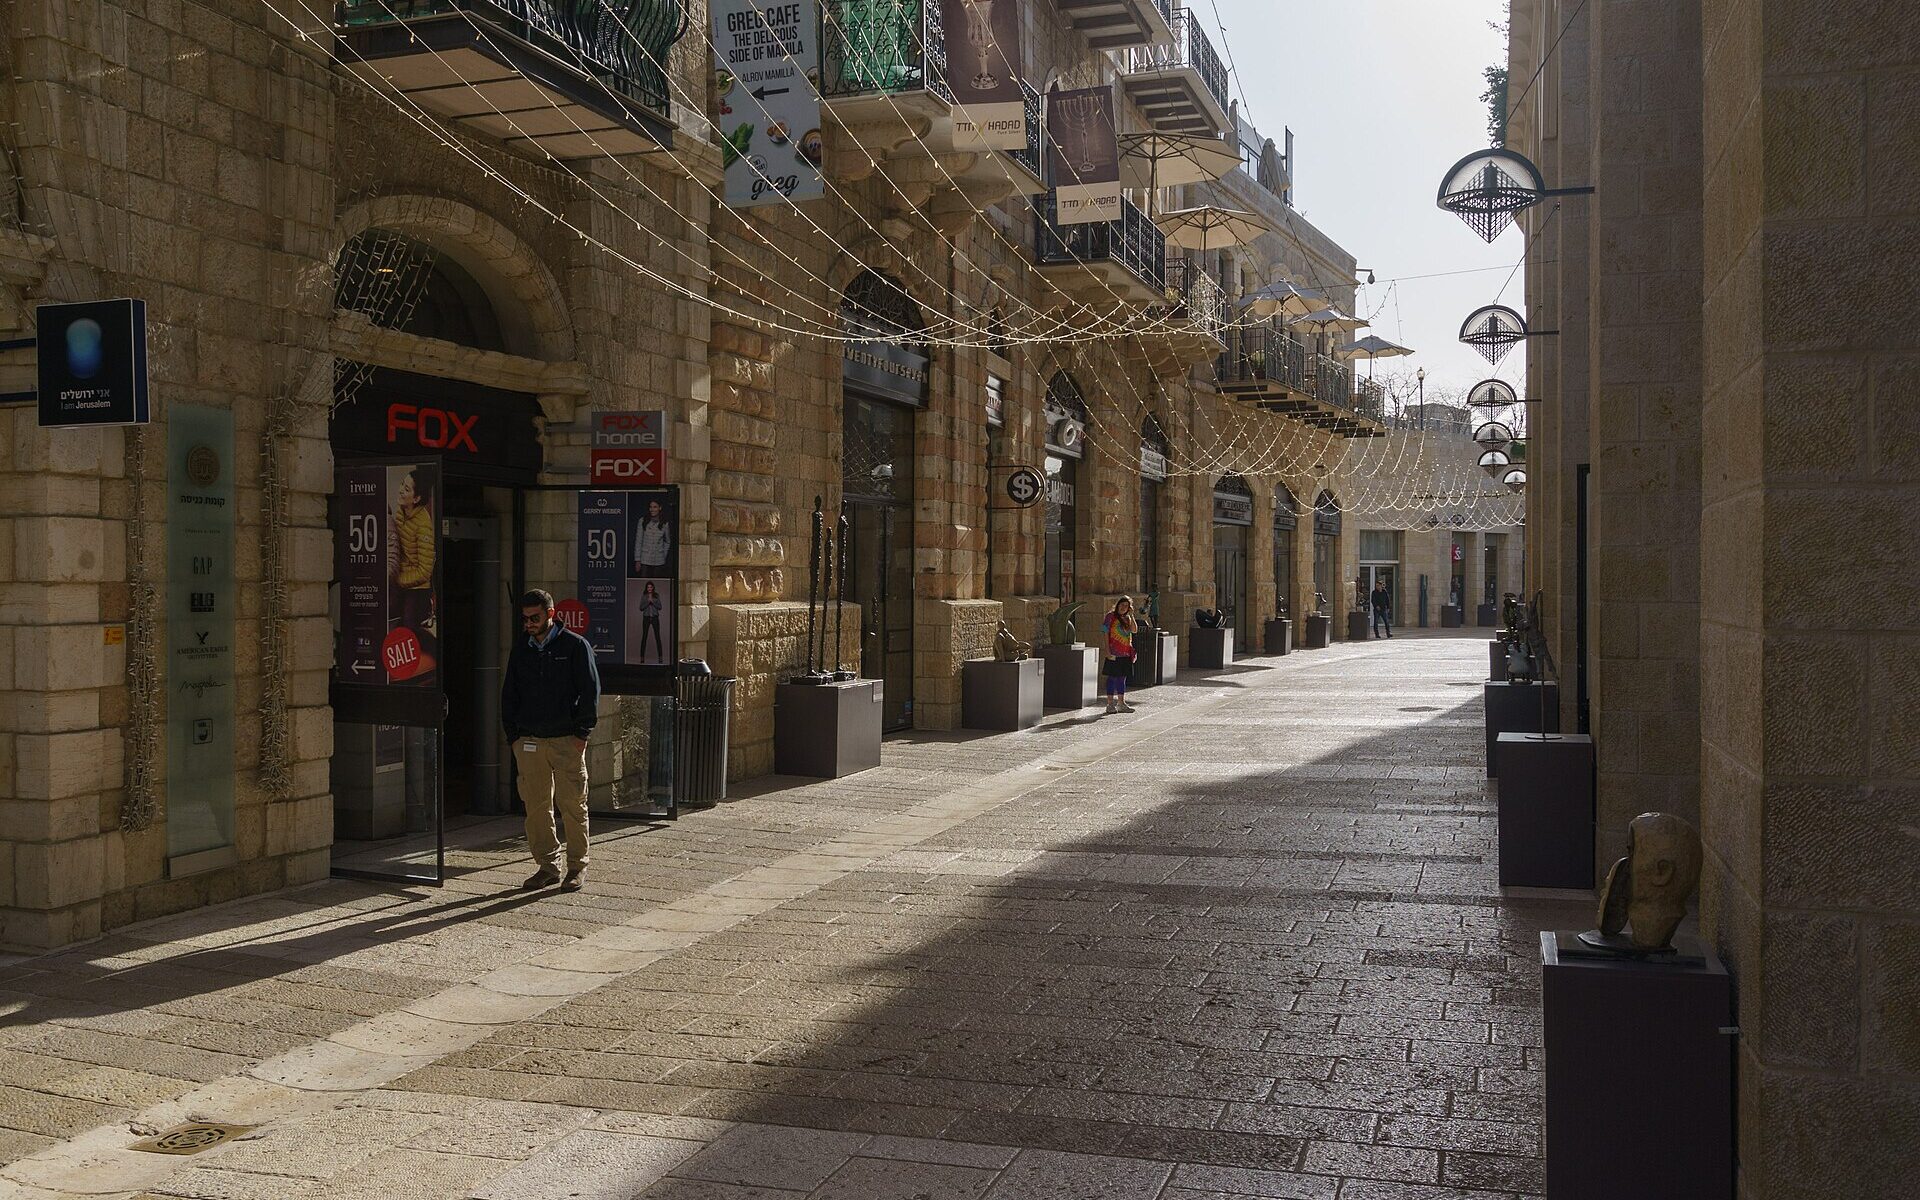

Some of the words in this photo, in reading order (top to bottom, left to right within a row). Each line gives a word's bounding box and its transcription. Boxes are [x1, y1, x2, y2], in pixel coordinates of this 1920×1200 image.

[767, 4, 801, 28] CAFE
[732, 33, 751, 47] THE
[729, 47, 751, 63] SIDE
[753, 47, 765, 60] OF
[742, 71, 763, 83] ALROV
[765, 67, 795, 81] MAMILLA
[988, 120, 1021, 130] HADAD
[751, 175, 800, 201] greg
[60, 390, 94, 400] ירושלים
[96, 389, 111, 398] אני
[76, 400, 111, 409] Jerusalem
[387, 402, 480, 453] FOX
[602, 415, 649, 430] FOX
[596, 431, 656, 445] home
[595, 458, 656, 477] FOX
[350, 480, 377, 494] irene
[193, 556, 213, 575] GAP
[350, 554, 377, 563] הנחה
[556, 610, 584, 629] SALE
[387, 638, 417, 669] SALE
